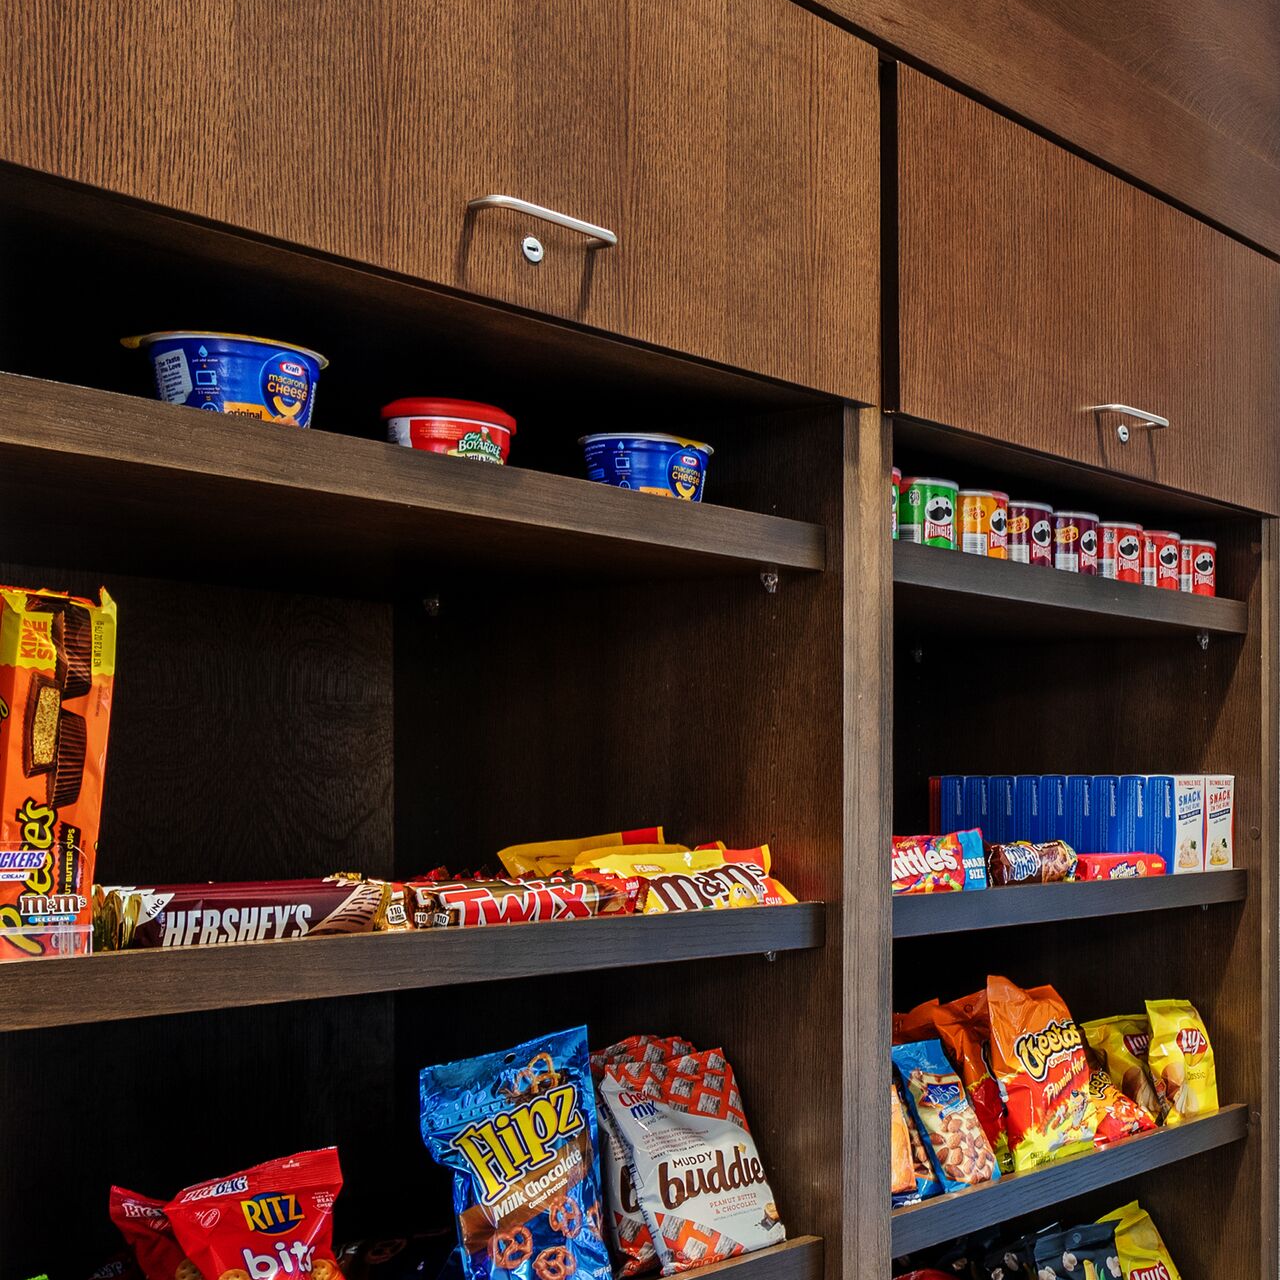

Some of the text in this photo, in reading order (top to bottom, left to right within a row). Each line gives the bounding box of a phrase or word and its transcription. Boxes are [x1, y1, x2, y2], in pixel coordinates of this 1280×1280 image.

[285, 364, 300, 374] Kraft
[464, 432, 480, 442] Chef
[683, 457, 696, 465] Kraft
[1179, 790, 1201, 806] SNACK
[1210, 790, 1230, 804] SNACK
[0, 852, 44, 868] CKERS
[892, 849, 957, 882] kittles
[969, 869, 985, 880] SIZE
[146, 898, 165, 918] KING
[162, 904, 312, 947] HERSHEY'S
[1072, 1057, 1085, 1075] Hot
[631, 1100, 659, 1119] mix
[451, 1085, 584, 1204] Flipz
[672, 1151, 712, 1169] MUDDY
[214, 1177, 248, 1195] BAG
[493, 1150, 582, 1221] Milk Chocolate
[658, 1146, 767, 1210] buddie
[240, 1194, 305, 1231] RITZ
[242, 1241, 316, 1280] bits
